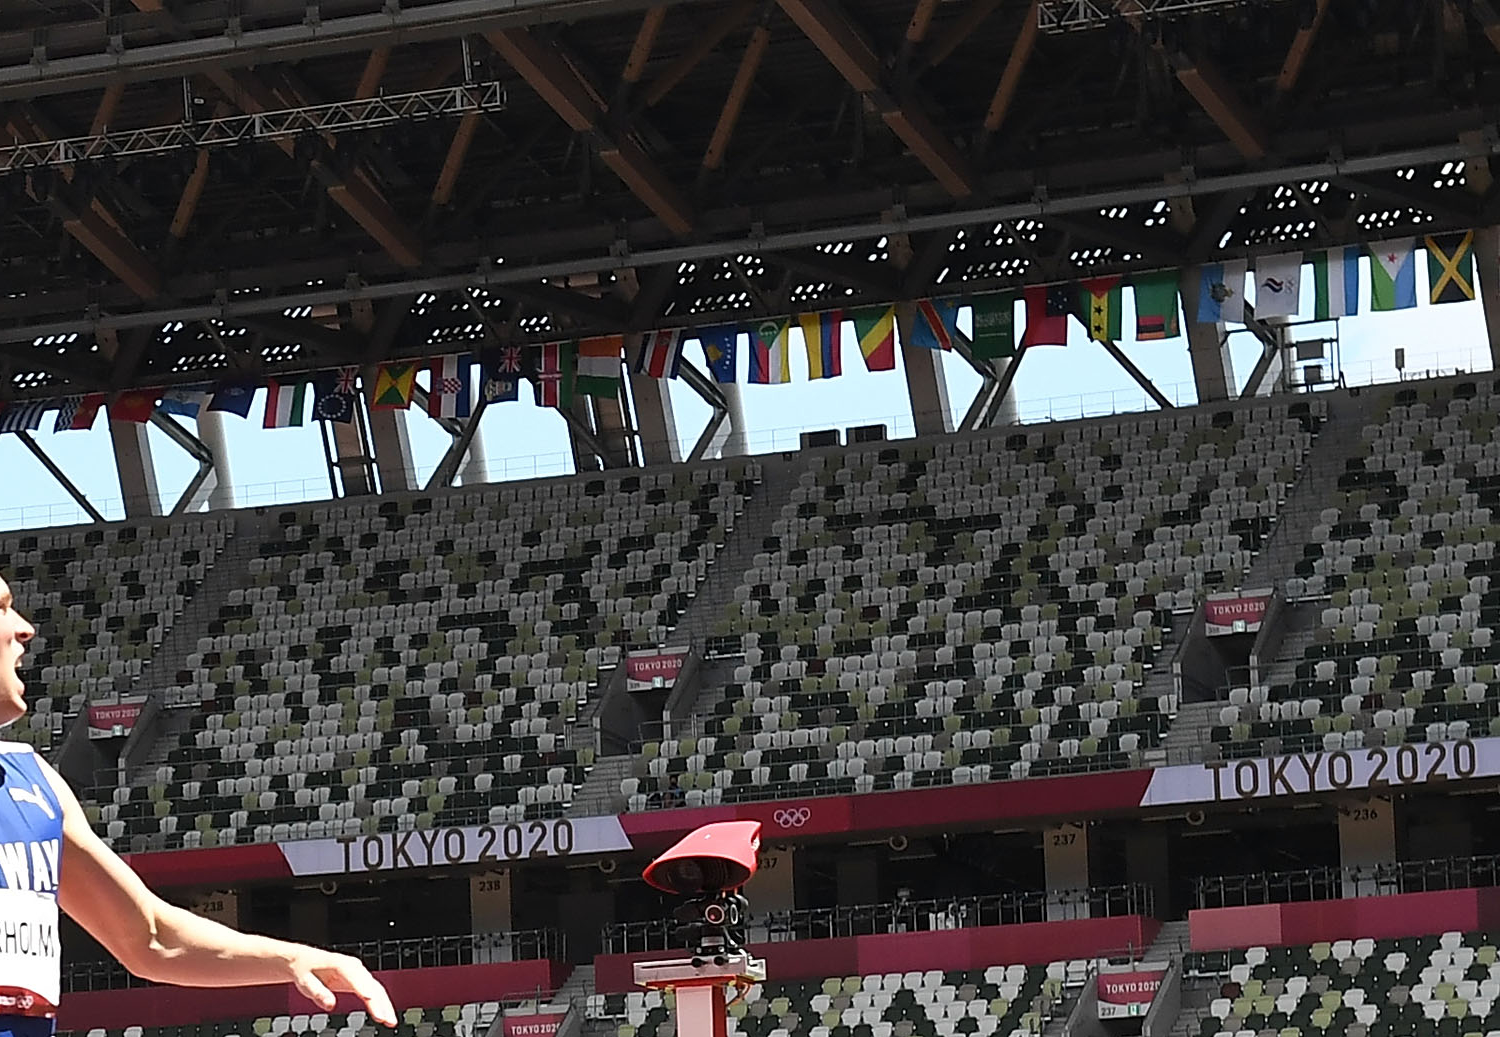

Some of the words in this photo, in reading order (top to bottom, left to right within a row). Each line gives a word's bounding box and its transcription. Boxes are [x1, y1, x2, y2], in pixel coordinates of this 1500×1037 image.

[1213, 604, 1242, 615] TOKYO
[1243, 601, 1265, 612] 2020
[635, 661, 660, 671] TOKYO
[662, 658, 682, 669] 2020
[95, 710, 120, 720] TOKYO
[1204, 750, 1353, 800] TOKYO
[1366, 738, 1476, 787] 2020
[1354, 808, 1378, 821] 236
[336, 827, 466, 872] TOKYO
[477, 818, 574, 864] 2020
[1053, 833, 1076, 846] 237
[759, 856, 778, 869] 37
[1106, 982, 1137, 994] TOKYO
[1100, 1006, 1117, 1016] 237
[511, 1024, 540, 1035] TOKYO
